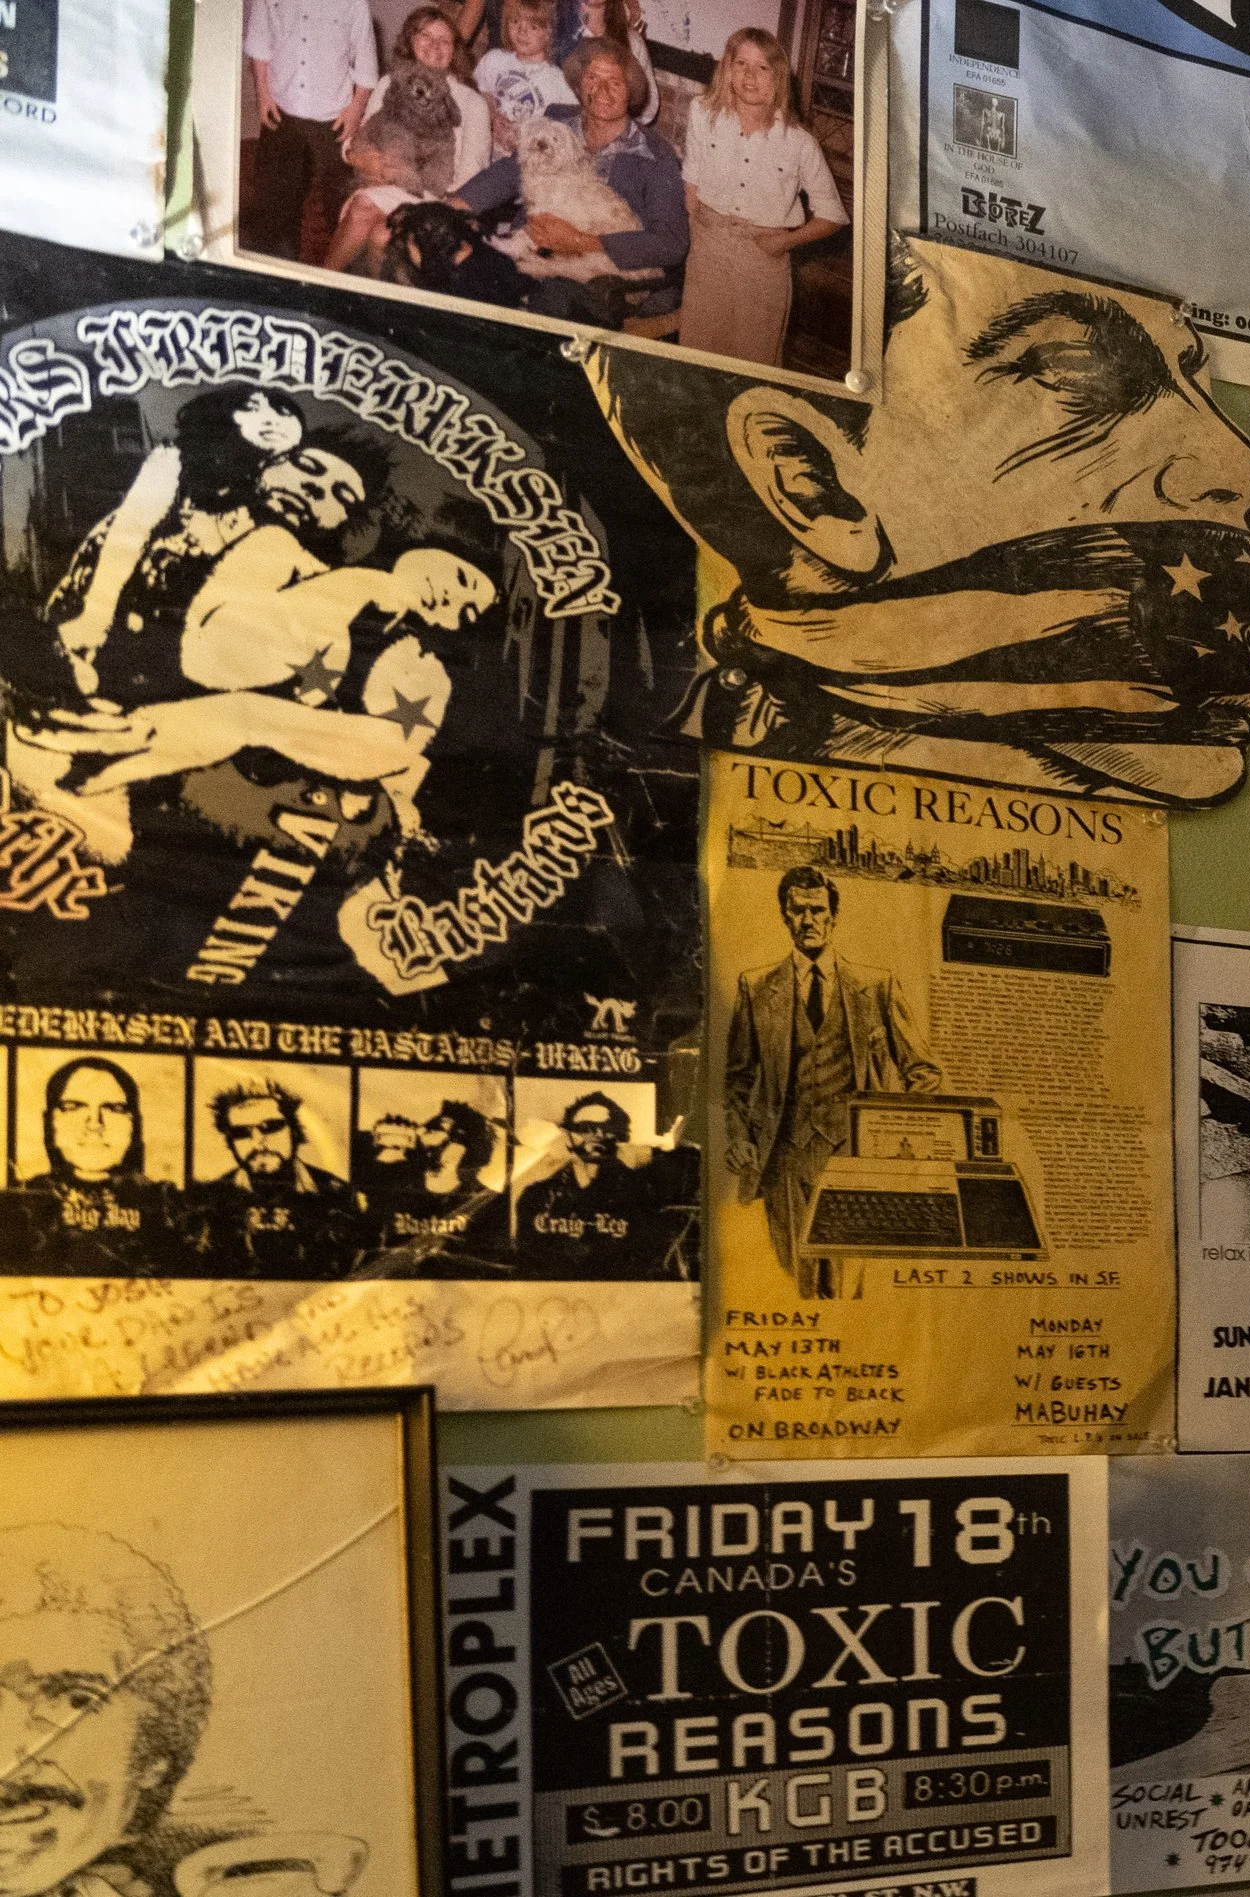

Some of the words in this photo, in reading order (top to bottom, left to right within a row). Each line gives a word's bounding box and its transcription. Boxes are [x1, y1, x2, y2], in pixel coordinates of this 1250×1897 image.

[933, 212, 1009, 248] Postfach
[1014, 230, 1079, 266] 304107
[731, 761, 898, 816] TOXIC
[912, 785, 1126, 845] REASONS
[186, 811, 340, 986] VIKING
[203, 1017, 271, 1050] AND
[276, 1021, 343, 1056] THE
[1202, 1245, 1246, 1262] relax
[893, 1270, 950, 1287] LAST
[990, 1270, 1058, 1286] SHOWS
[724, 1309, 822, 1330] FRIDAY
[1029, 1317, 1105, 1335] MONDAY
[724, 1339, 782, 1356] MAY
[790, 1338, 842, 1355] 13TH
[1016, 1344, 1056, 1359] MAY
[1065, 1344, 1111, 1359] 16TH
[754, 1364, 811, 1381] BLACK
[818, 1362, 900, 1381] ATHLETES
[1050, 1374, 1123, 1392] GUESTS
[754, 1386, 803, 1402] FADE
[846, 1386, 906, 1402] BLACK
[728, 1420, 766, 1440] ON
[776, 1416, 902, 1440] BROADWAY
[1014, 1401, 1130, 1425] MABUHAY
[565, 1498, 876, 1563] FRIDAY
[898, 1495, 1016, 1568] 18
[639, 1559, 858, 1598] CANADA'S
[1110, 1543, 1222, 1603] YOU
[628, 1595, 1026, 1703] TOXIC
[607, 1694, 1008, 1779] REASONS
[724, 1769, 888, 1836] KGB
[912, 1771, 991, 1802] 8:30
[1111, 1782, 1204, 1809] SOCIAL
[626, 1798, 703, 1828] 8.00
[1115, 1808, 1208, 1831] UNREST
[587, 1852, 732, 1892] RIGHTS
[743, 1846, 791, 1875] OF
[803, 1838, 874, 1869] THE
[882, 1820, 1043, 1857] ACCUSED
